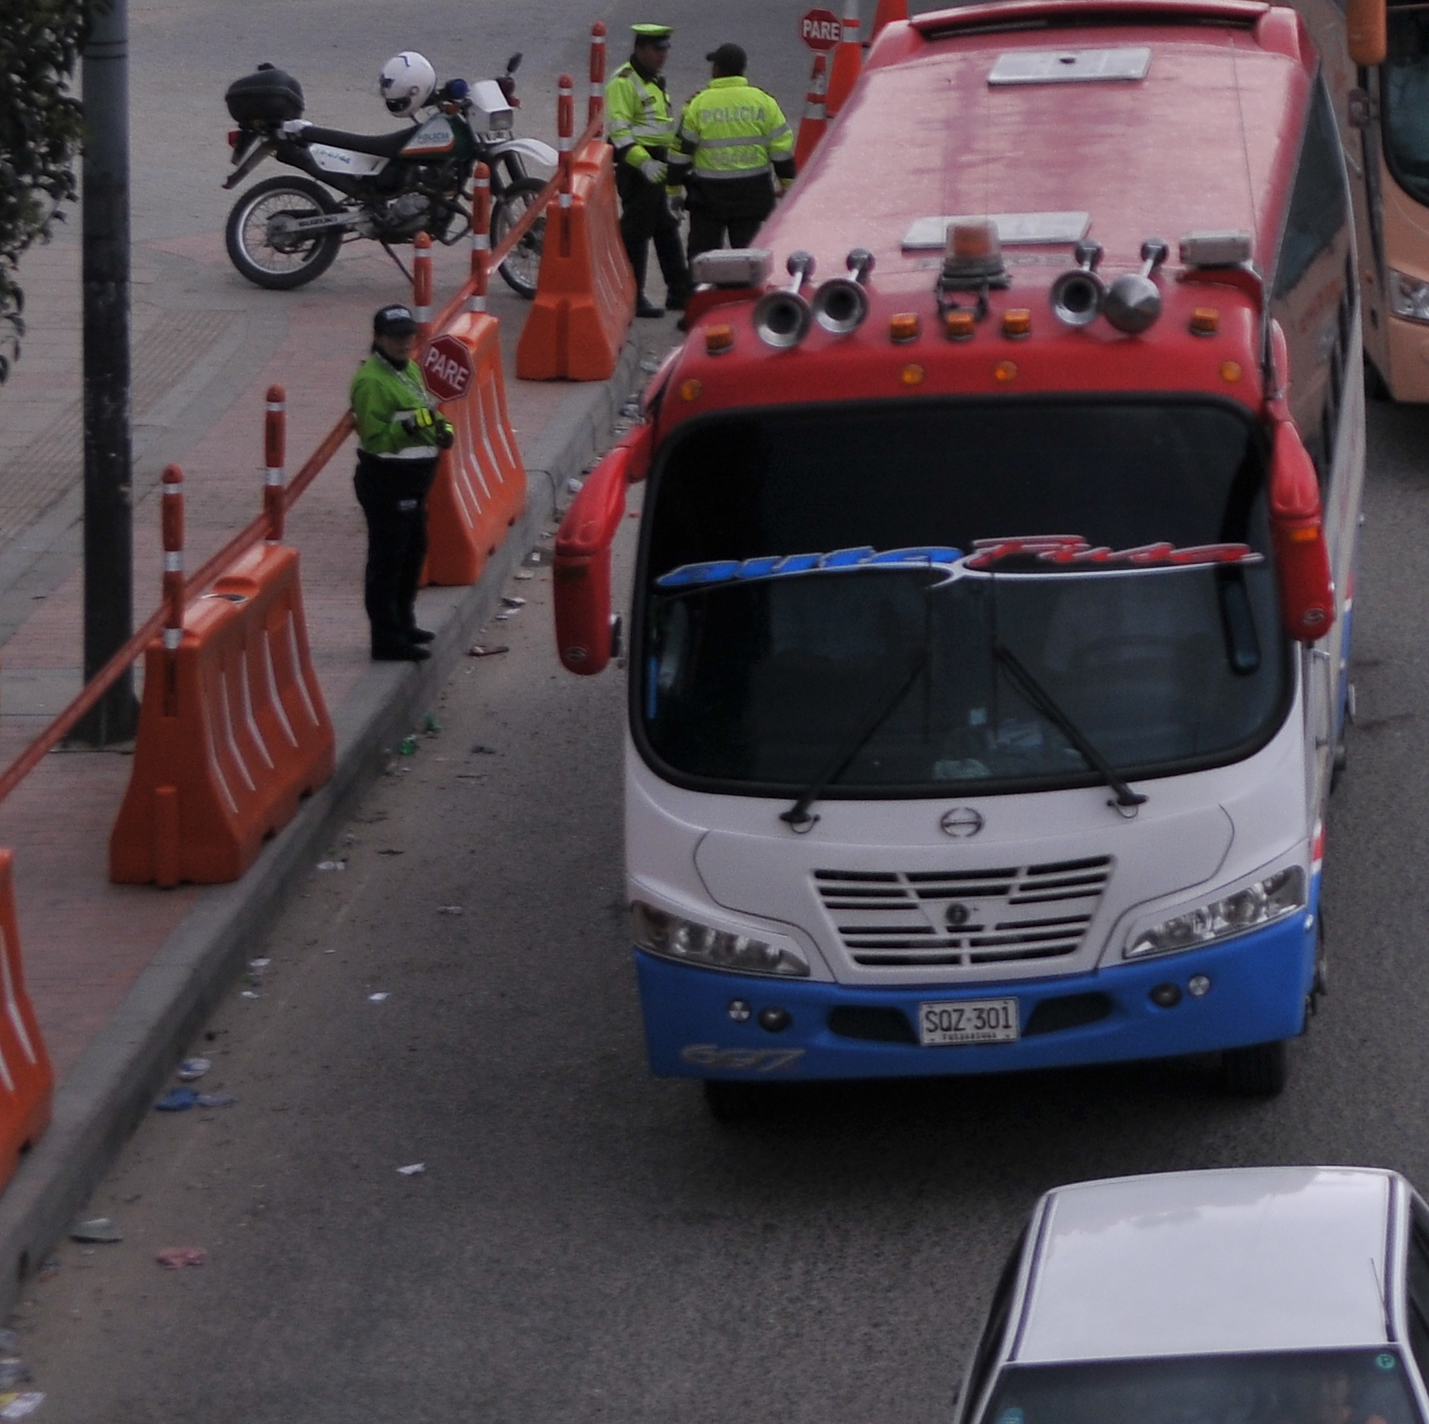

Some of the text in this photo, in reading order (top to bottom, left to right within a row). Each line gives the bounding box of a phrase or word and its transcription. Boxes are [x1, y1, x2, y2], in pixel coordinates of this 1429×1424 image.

[803, 19, 840, 42] PARE
[700, 106, 766, 123] POLICIA
[424, 346, 469, 391] PARE
[924, 1007, 1013, 1033] SQZ-301
